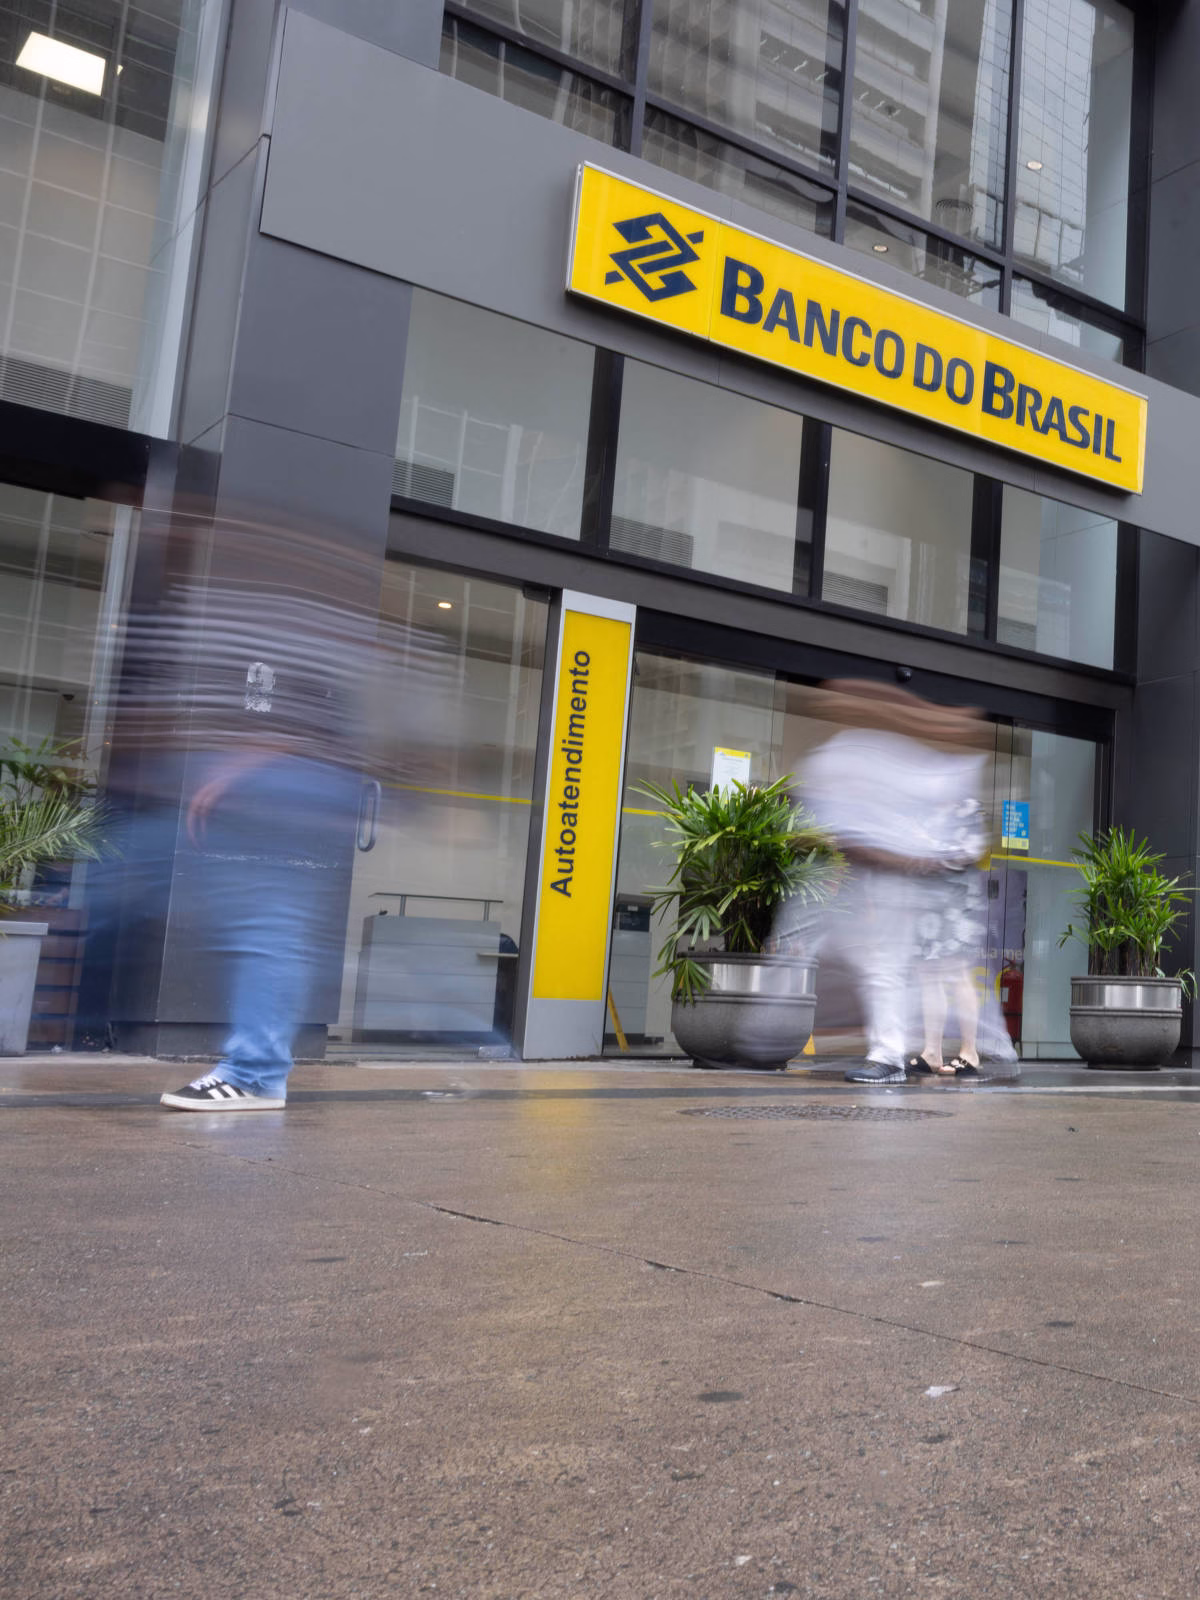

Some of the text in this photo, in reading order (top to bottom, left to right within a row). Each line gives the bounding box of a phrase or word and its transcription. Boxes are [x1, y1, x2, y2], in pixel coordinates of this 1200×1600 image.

[720, 255, 1122, 464] BANCO DO BRASIL
[550, 650, 591, 898] Autoatendimento
